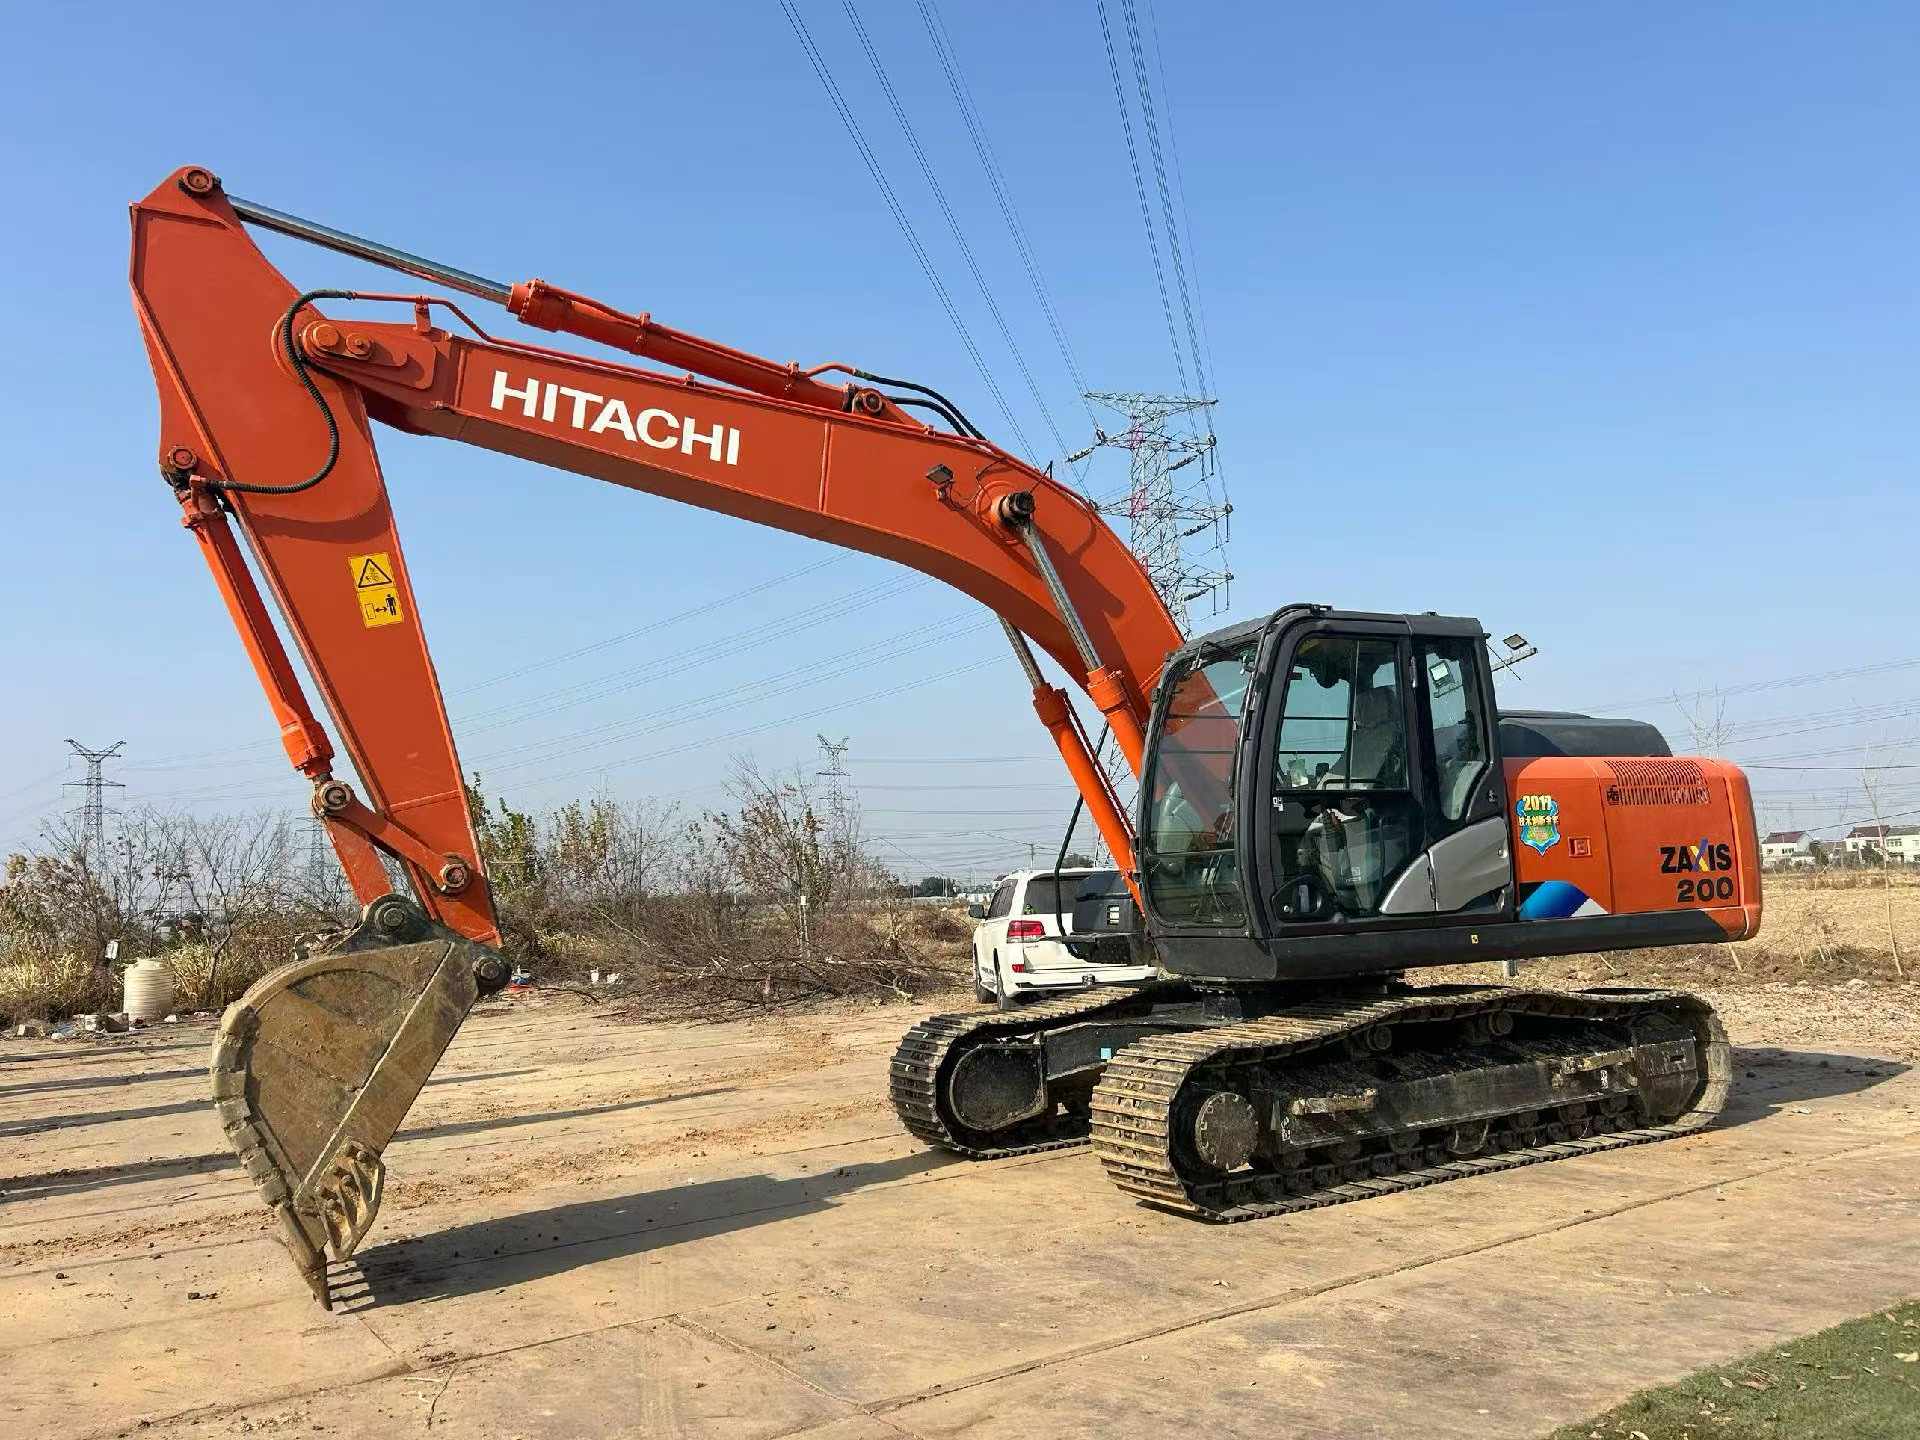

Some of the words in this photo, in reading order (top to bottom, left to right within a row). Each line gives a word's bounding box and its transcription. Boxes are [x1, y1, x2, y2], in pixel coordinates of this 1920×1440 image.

[490, 370, 741, 465] HITACHI
[1660, 837, 1732, 873] ZAXIS
[1677, 877, 1734, 902] 200
